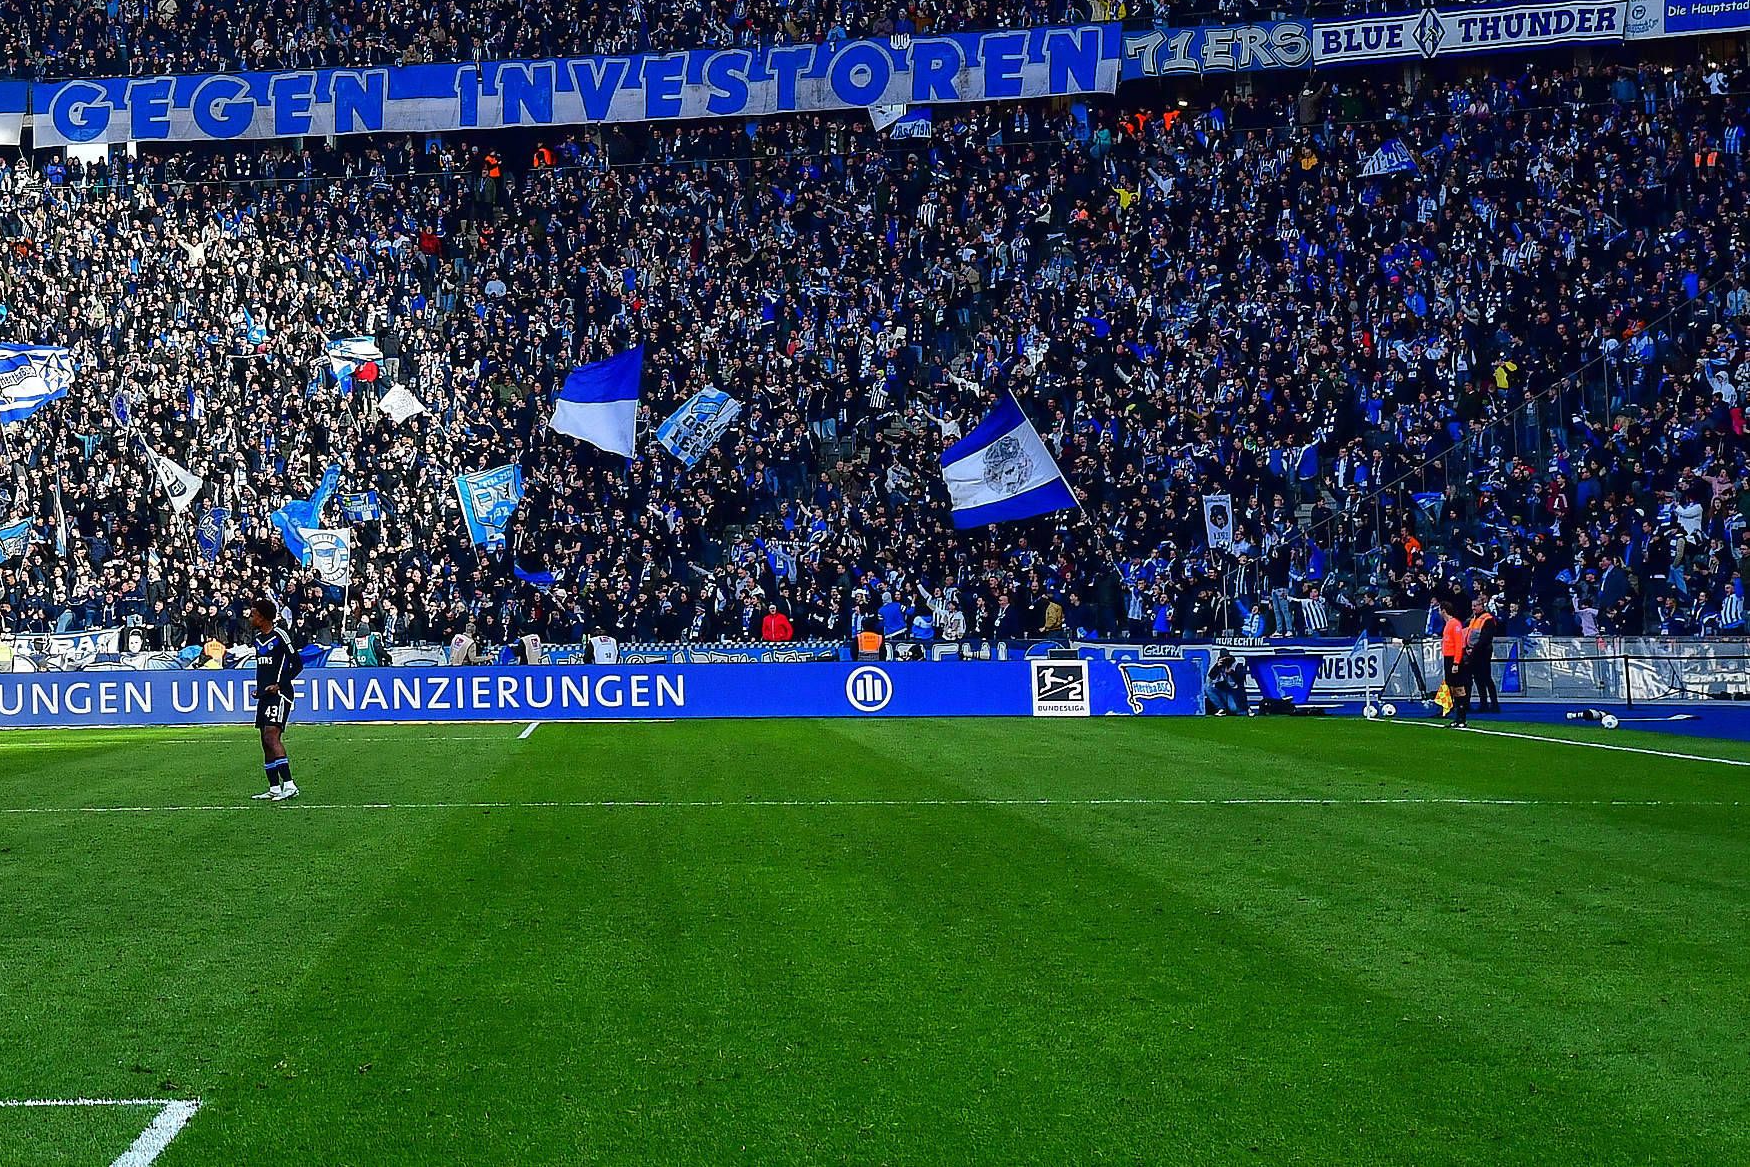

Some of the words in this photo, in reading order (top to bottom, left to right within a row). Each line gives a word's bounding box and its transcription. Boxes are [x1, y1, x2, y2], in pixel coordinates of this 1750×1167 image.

[1667, 5, 1687, 17] Die
[1321, 23, 1404, 54] BLUE
[1457, 7, 1618, 45] THUNDER
[50, 66, 389, 143] GEGEN
[453, 28, 1106, 127] INVESTOREN
[1233, 638, 1253, 646] ECHT
[291, 674, 685, 711] FINANZIERUNGEN
[1067, 686, 1082, 700] 2
[1133, 680, 1172, 694] HerthaBSC
[264, 705, 279, 718] 43
[1037, 704, 1086, 712] BUNDESLIGA
